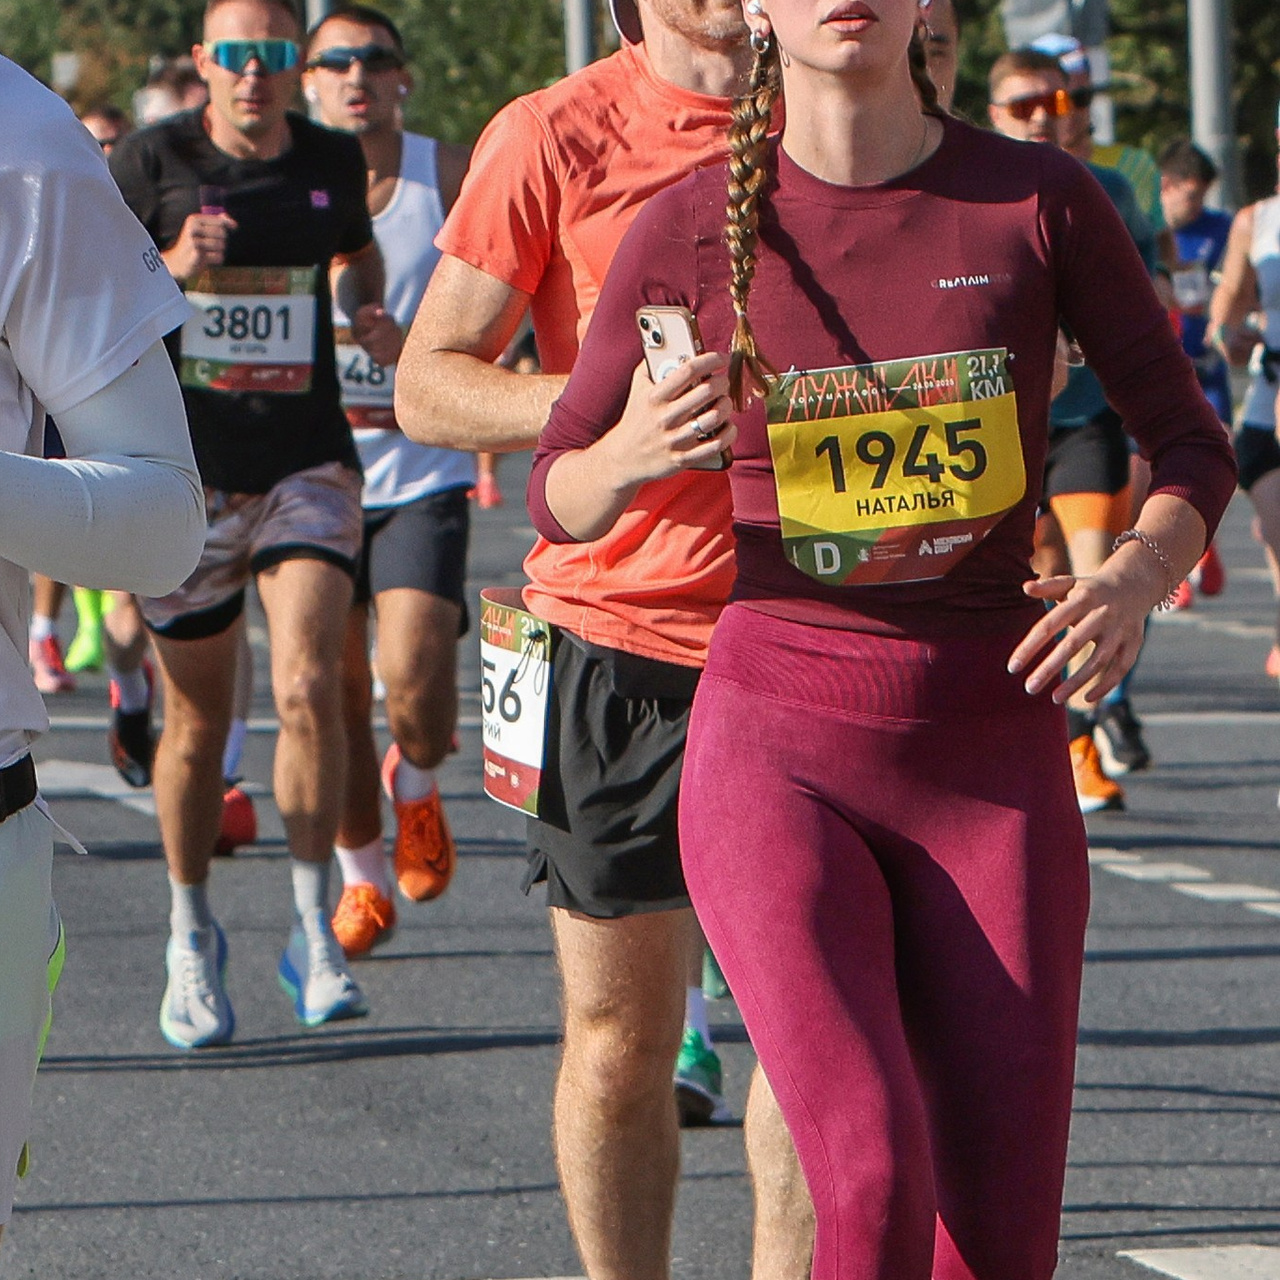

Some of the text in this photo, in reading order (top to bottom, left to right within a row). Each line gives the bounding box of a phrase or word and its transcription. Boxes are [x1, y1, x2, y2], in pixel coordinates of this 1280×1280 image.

[203, 303, 290, 340] 3801
[815, 418, 987, 494] 1945
[856, 489, 955, 517] НАТАЛЬЯ
[814, 541, 842, 575] D
